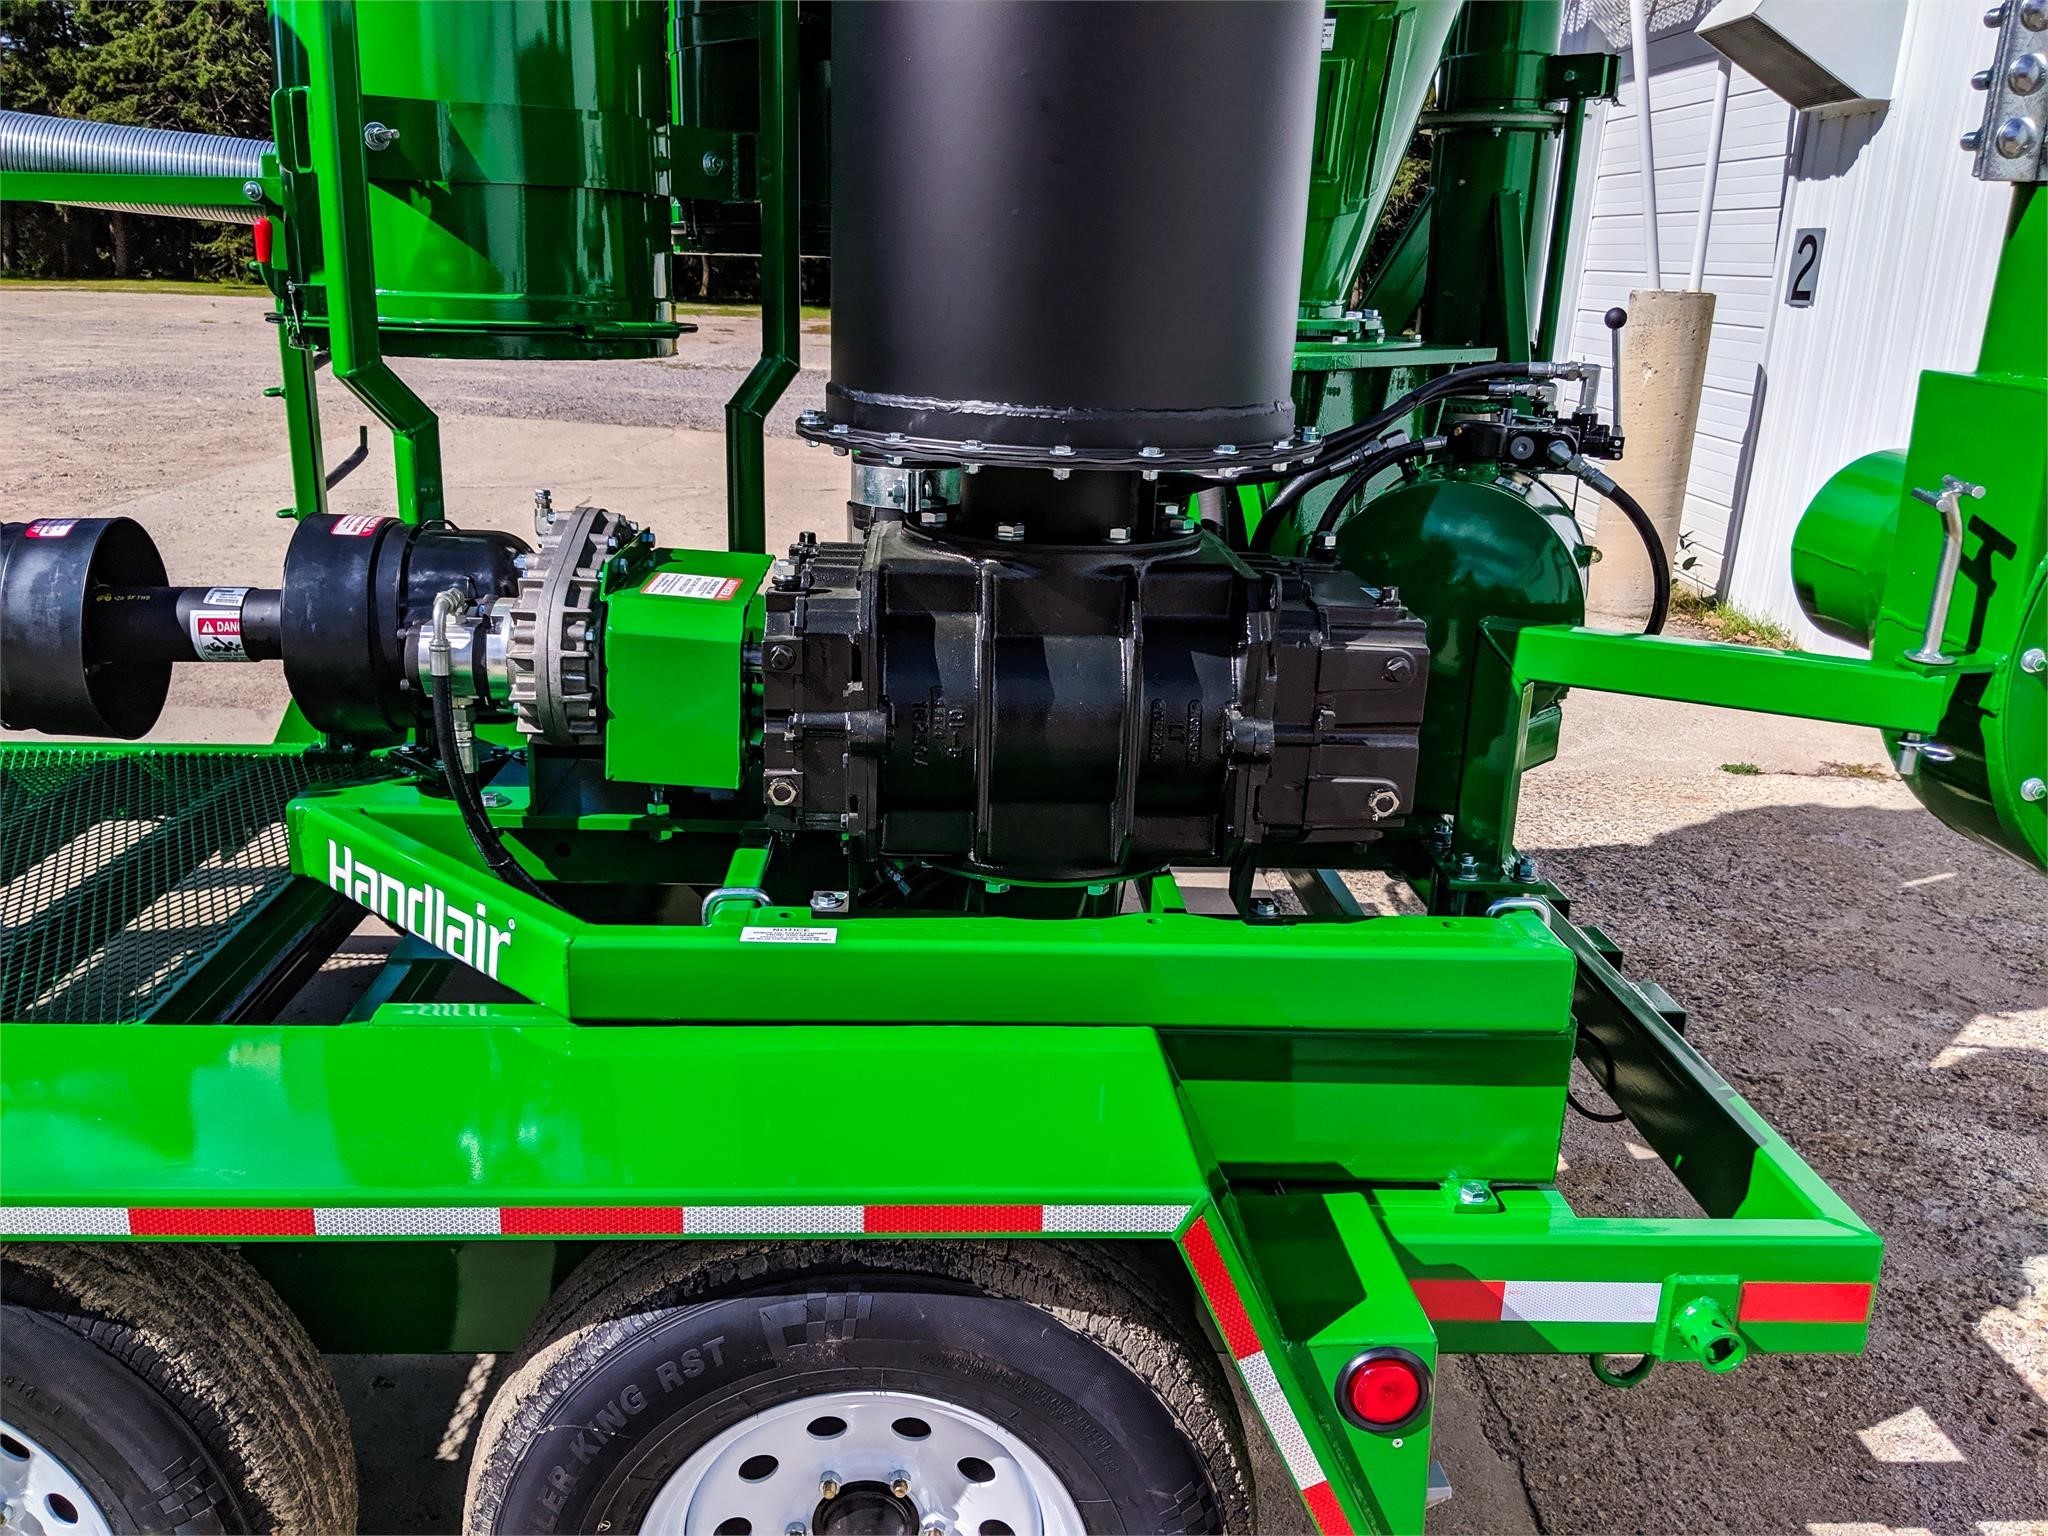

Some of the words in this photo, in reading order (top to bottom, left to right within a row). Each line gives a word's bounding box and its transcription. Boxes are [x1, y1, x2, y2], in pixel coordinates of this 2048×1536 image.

[1791, 234, 1818, 301] 2
[328, 838, 512, 981] Handlair
[568, 1384, 649, 1465] KING
[656, 1336, 726, 1393] RST
